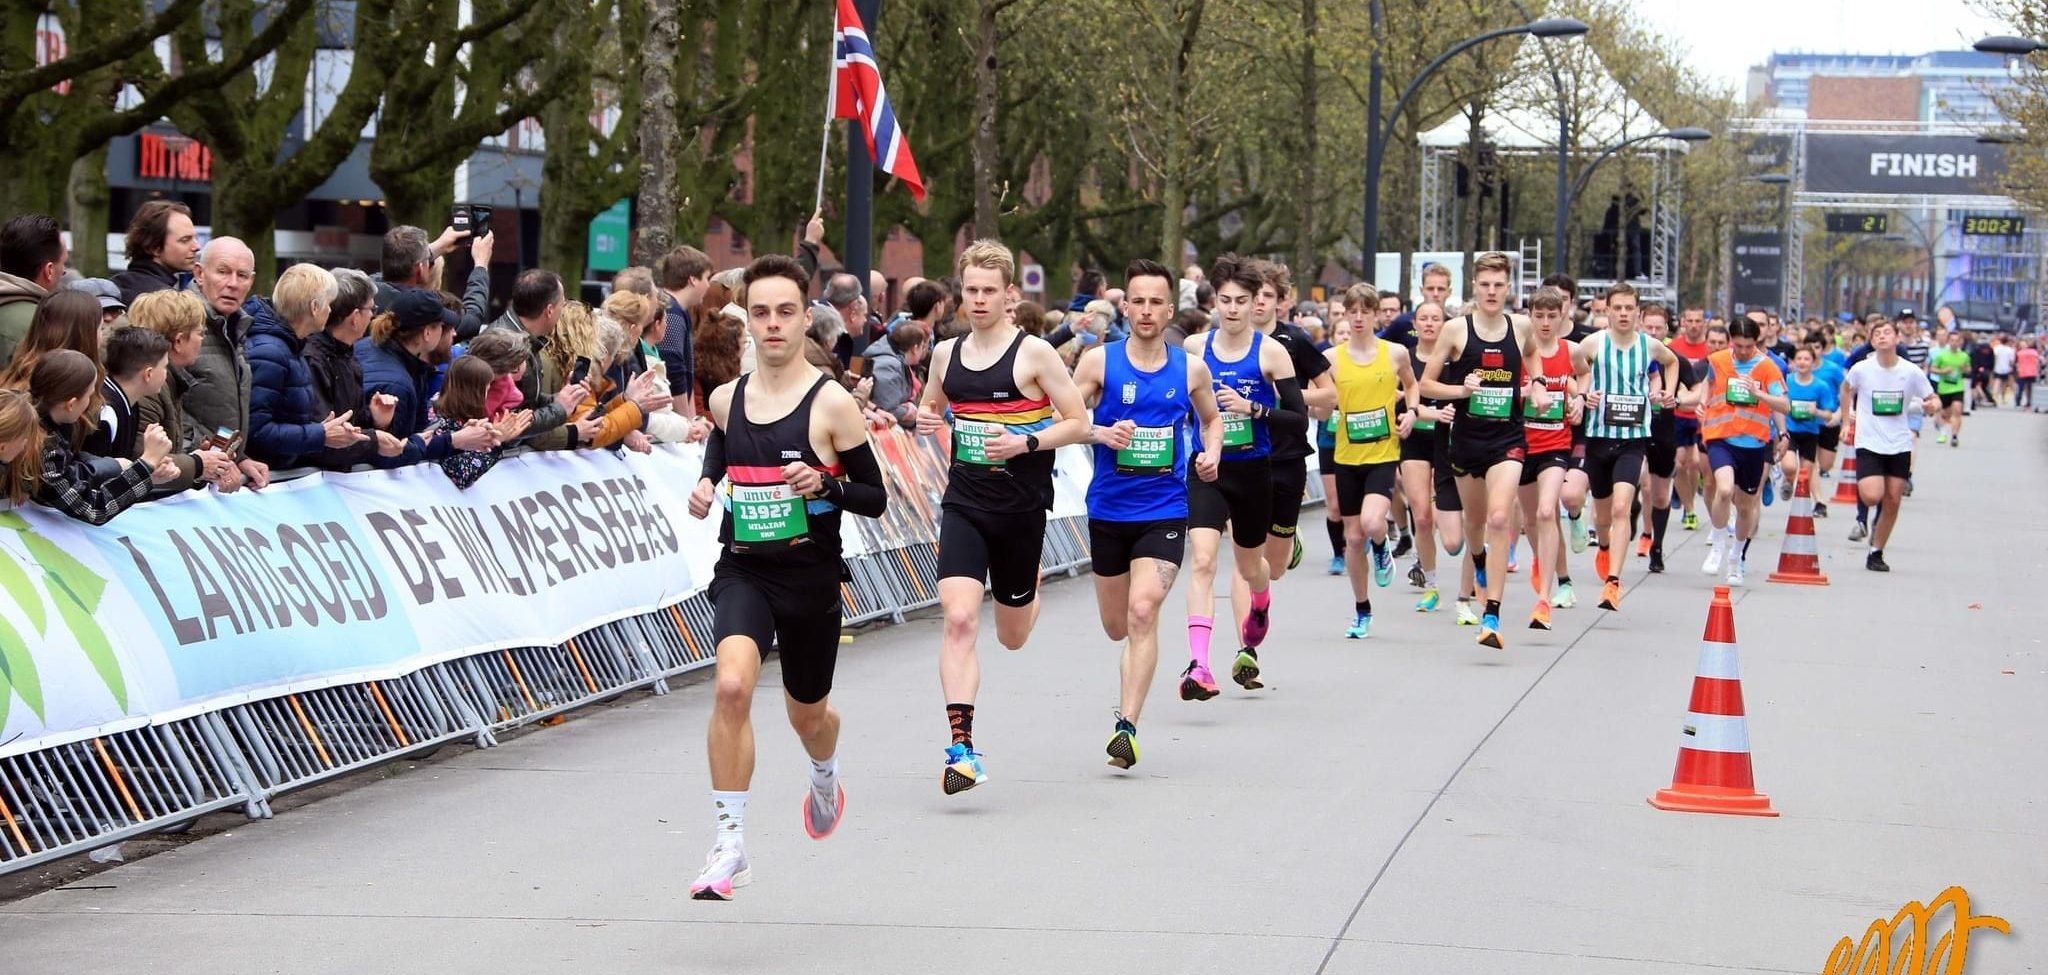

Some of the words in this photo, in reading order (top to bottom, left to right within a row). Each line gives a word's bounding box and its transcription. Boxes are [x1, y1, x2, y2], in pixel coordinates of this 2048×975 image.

[1870, 153, 1977, 177] FINISH
[1126, 440, 1167, 451] 13282
[743, 486, 782, 501] univé
[740, 502, 792, 520] 13927
[748, 521, 786, 531] WILLIAM
[116, 520, 389, 646] LANDGOED
[366, 508, 467, 605] DE
